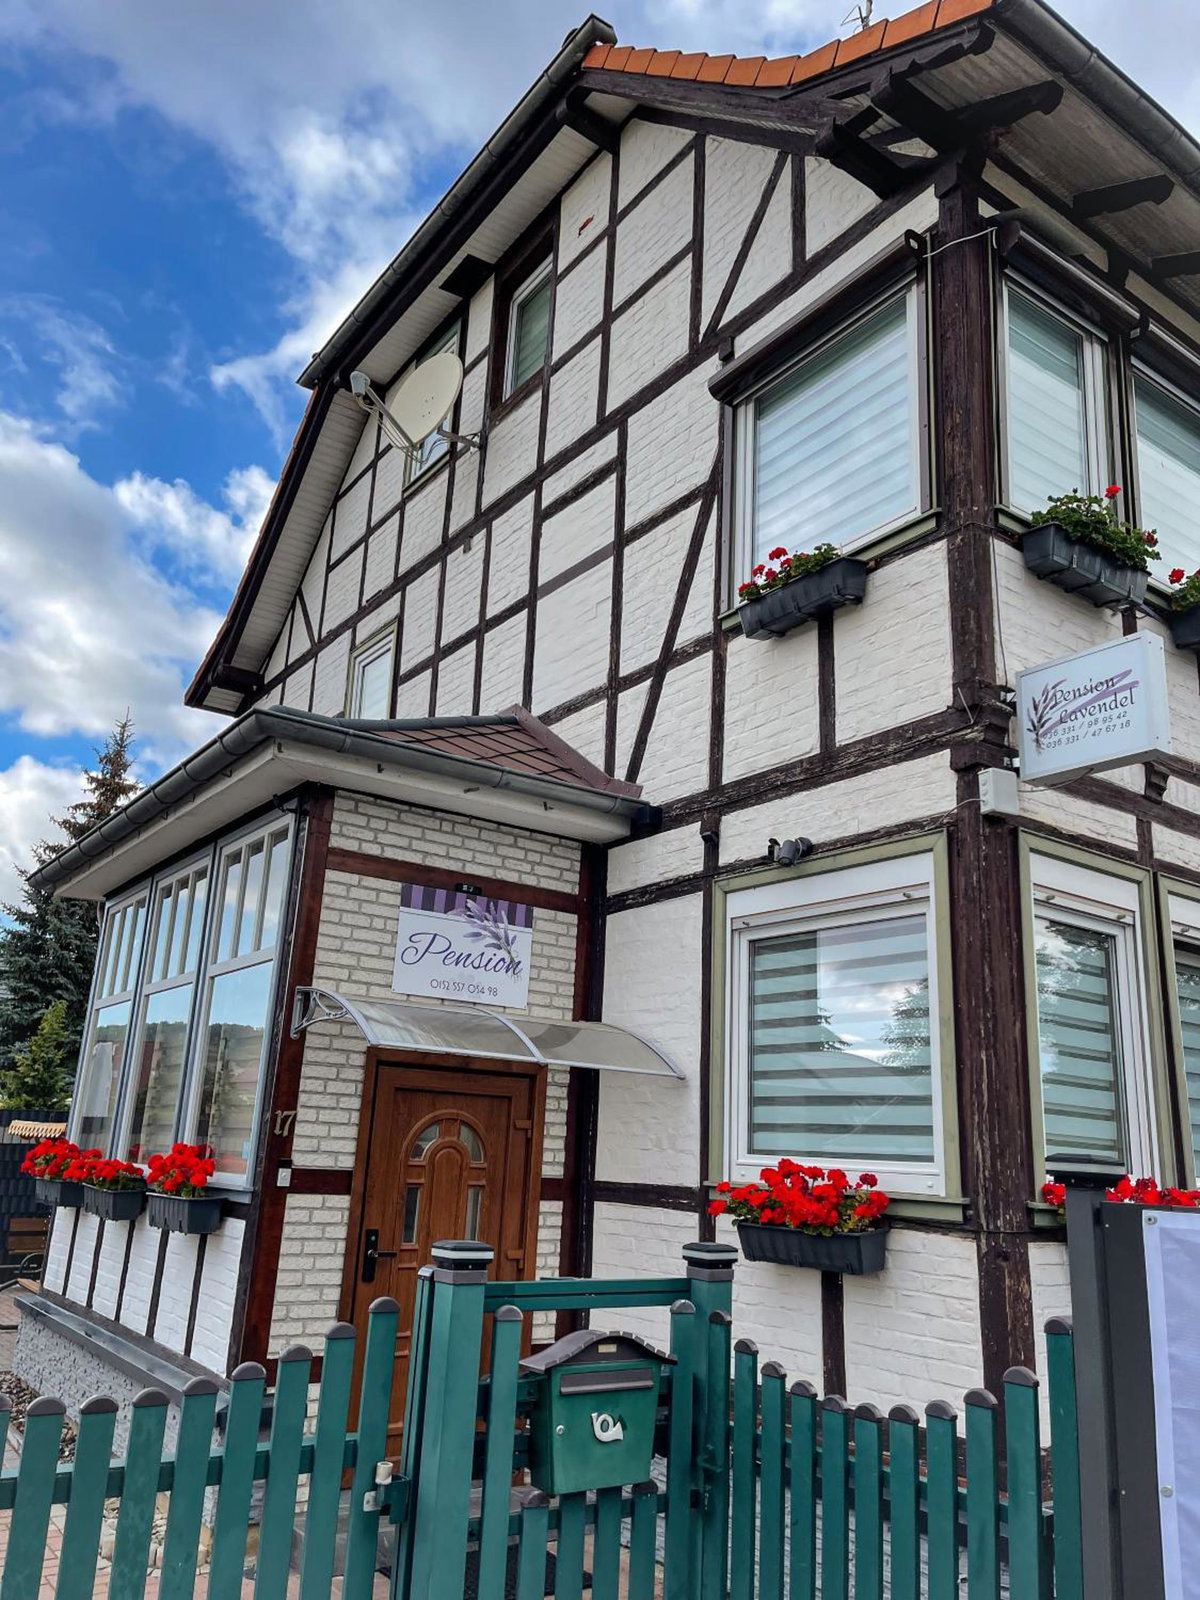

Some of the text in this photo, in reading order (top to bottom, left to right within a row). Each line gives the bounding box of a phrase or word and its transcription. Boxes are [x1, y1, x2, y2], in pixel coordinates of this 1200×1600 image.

[1051, 677, 1116, 706] Pension
[1059, 686, 1135, 724] Lavendel
[1046, 738, 1062, 749] 036
[1065, 734, 1080, 746] 331
[1091, 728, 1103, 737] 47
[1105, 724, 1117, 733] 67
[1120, 720, 1131, 729] 18
[1061, 725, 1076, 736] 331
[1087, 717, 1099, 729] 98
[1102, 714, 1113, 724] 95
[1116, 711, 1128, 720] 42
[401, 932, 523, 976] Pension
[430, 979, 498, 997] 0152 557 054 98
[274, 1110, 297, 1137] 17
